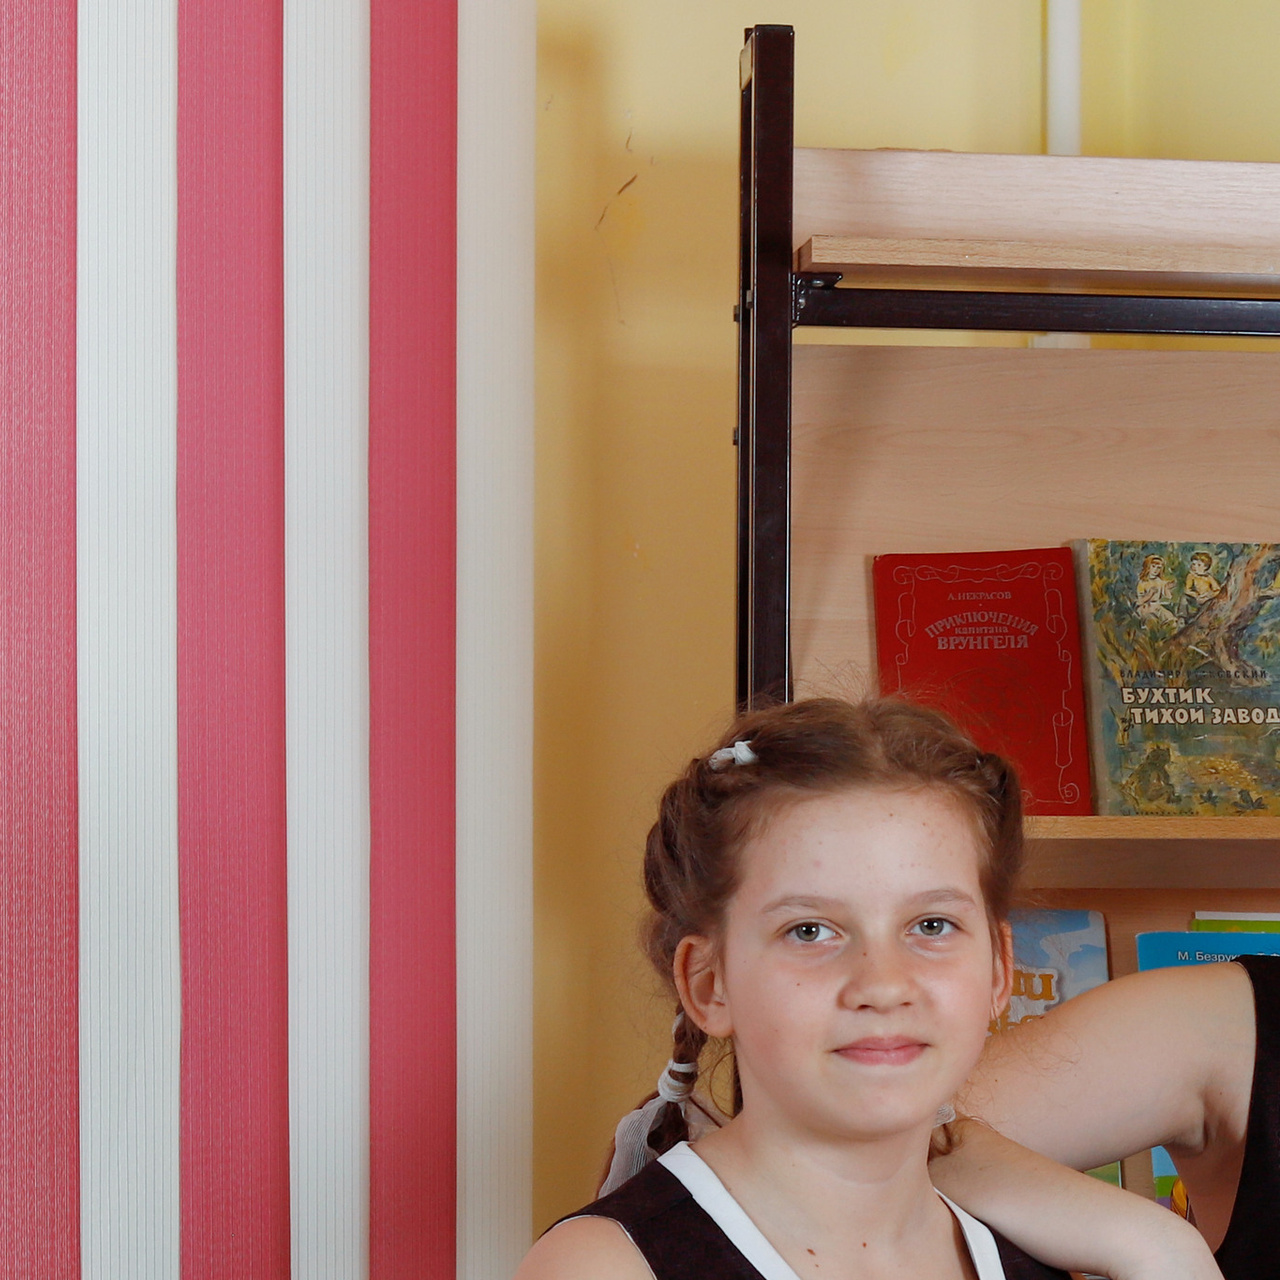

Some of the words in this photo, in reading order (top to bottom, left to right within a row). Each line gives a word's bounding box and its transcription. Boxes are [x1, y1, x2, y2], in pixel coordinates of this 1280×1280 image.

[924, 610, 1040, 639] ПРИКЛЮЧЕНИЯ
[954, 625, 1009, 635] капитана
[936, 634, 1029, 651] ВРУНГЕЛЯ
[1120, 686, 1216, 705] БУХТИК
